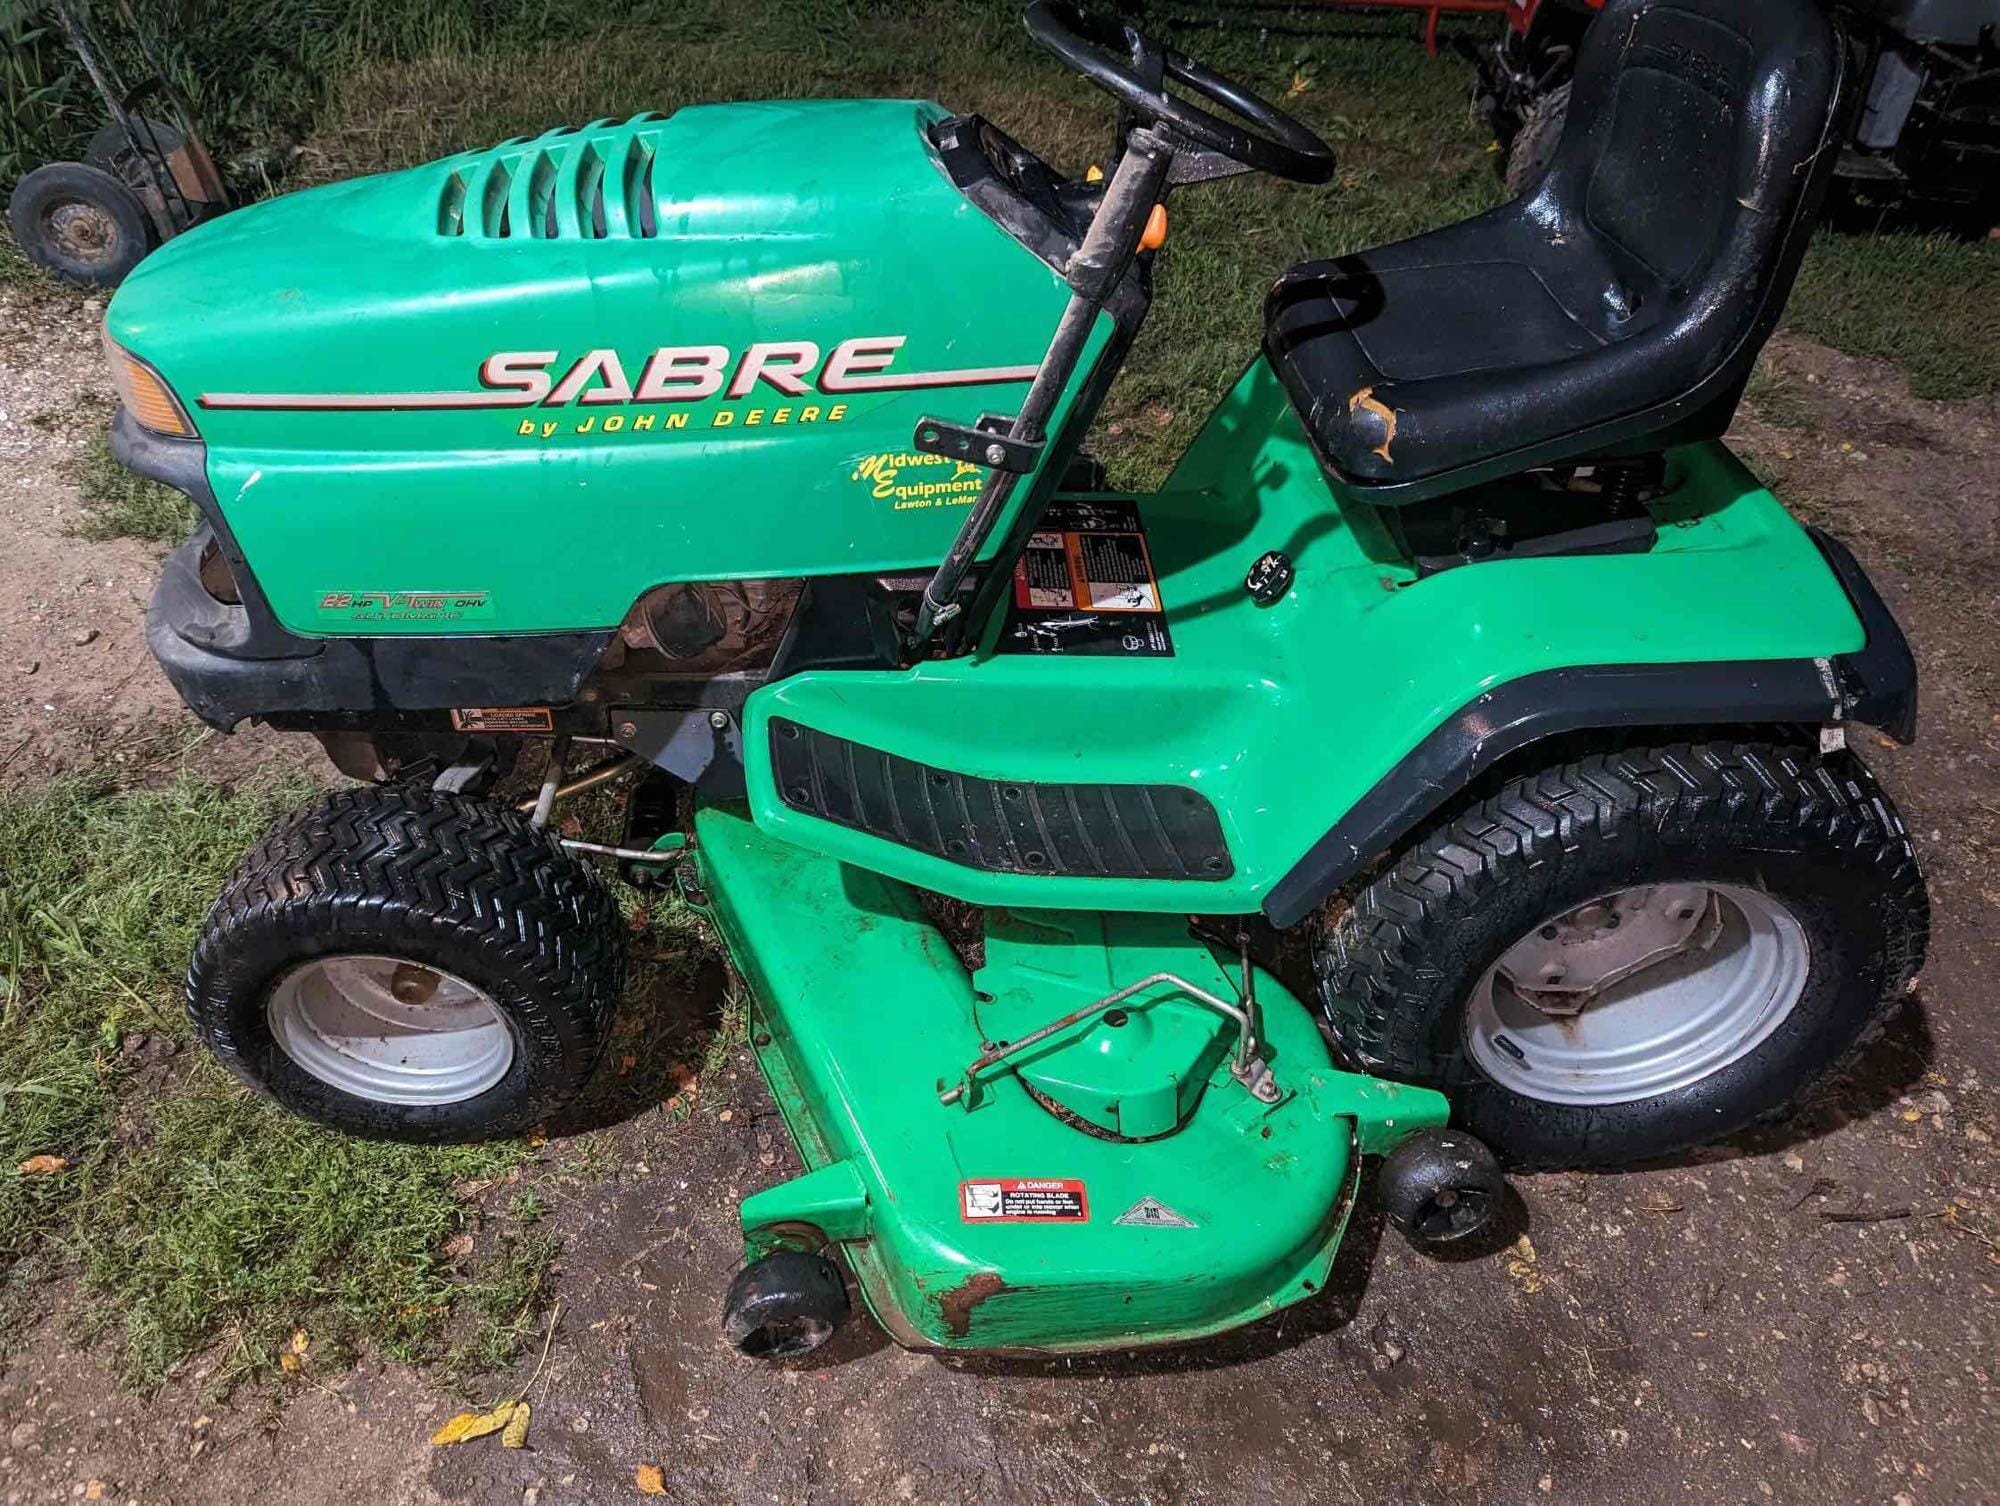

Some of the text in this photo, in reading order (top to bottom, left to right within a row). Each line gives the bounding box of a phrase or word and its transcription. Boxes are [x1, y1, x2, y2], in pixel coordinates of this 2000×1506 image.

[478, 335, 906, 407] SABRE
[517, 405, 848, 438] by JOHN DEERE
[852, 452, 951, 483] Midwest
[873, 469, 983, 500] Equipment
[894, 494, 978, 510] Lawton & LeMar
[1027, 1182, 1064, 1190] DANGER
